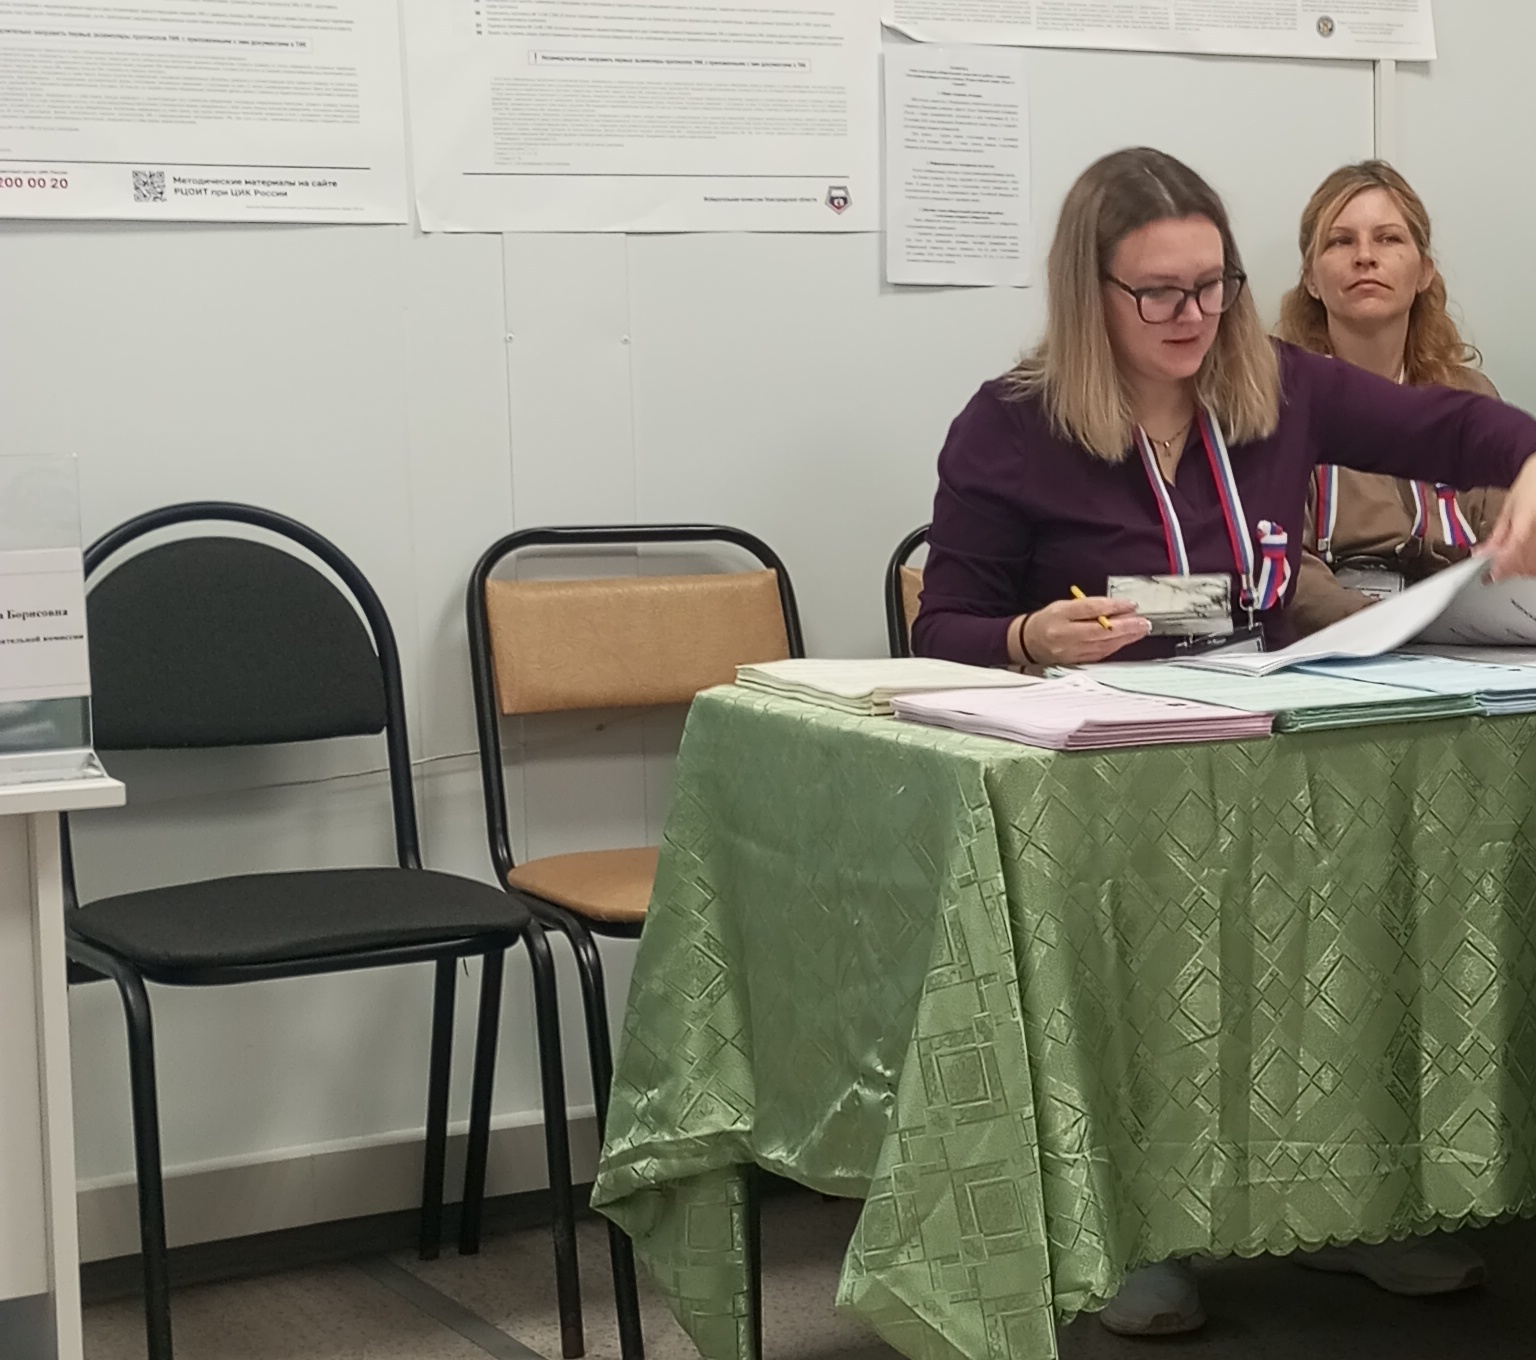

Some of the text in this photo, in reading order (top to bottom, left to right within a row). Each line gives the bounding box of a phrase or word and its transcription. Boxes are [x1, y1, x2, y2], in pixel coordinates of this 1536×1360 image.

[27, 177, 46, 189] 00
[50, 178, 69, 189] 20
[173, 176, 338, 189] Методические материалы на сайте
[211, 190, 229, 198] при
[231, 189, 250, 198] ЦИК
[253, 189, 288, 198] России
[7, 609, 68, 621] Борисовна
